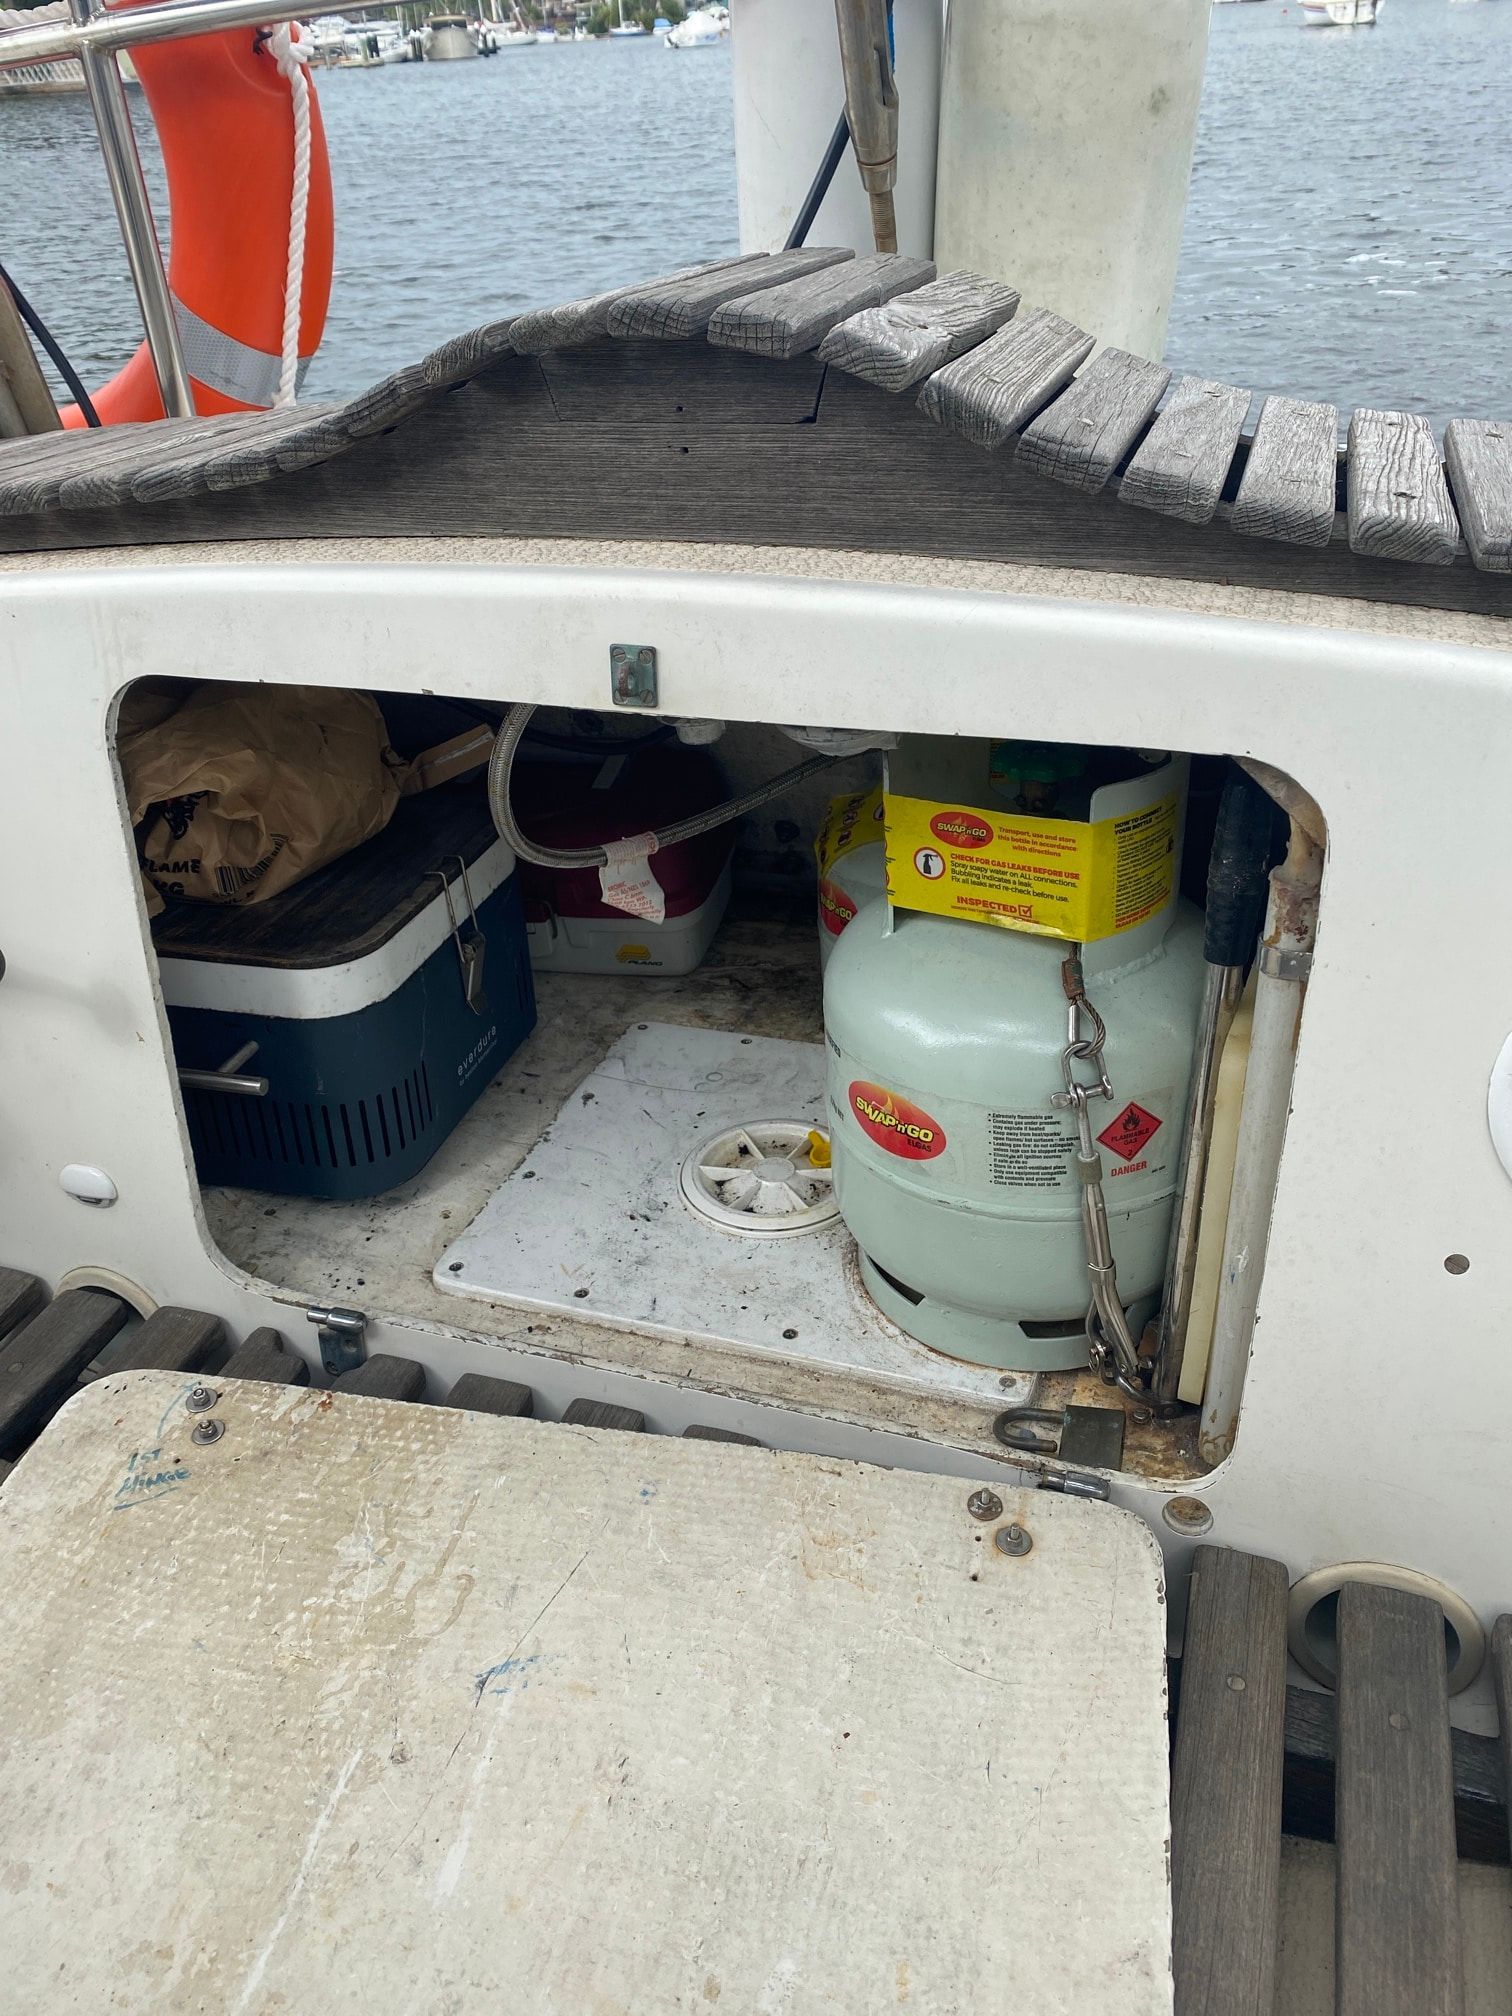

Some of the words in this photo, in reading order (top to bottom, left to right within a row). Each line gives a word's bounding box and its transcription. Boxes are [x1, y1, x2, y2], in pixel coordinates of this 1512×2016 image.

[1114, 820, 1130, 829] HOW
[1131, 816, 1140, 825] TO
[1115, 826, 1132, 835] YOUR
[1132, 818, 1152, 830] BOTTLE
[1011, 836, 1031, 845] bottle
[1040, 841, 1076, 852] accordance
[1058, 836, 1076, 844] store
[1028, 846, 1062, 858] directions
[951, 852, 976, 863] CHECK
[976, 856, 990, 866] FOR
[992, 860, 1007, 869] GAS
[1008, 862, 1032, 872] LEAKS
[1033, 866, 1063, 878] BEFORE
[1064, 872, 1080, 880] USE
[951, 860, 968, 870] Spray
[970, 864, 988, 874] soapy
[990, 868, 1008, 876] water
[1020, 872, 1032, 881] ALL
[1034, 876, 1078, 888] connections.
[951, 868, 981, 881] Bubbling
[982, 873, 1012, 884] indicates
[1018, 879, 1034, 888] leak.
[951, 876, 961, 884] Fix
[962, 877, 970, 885] all
[970, 878, 988, 888] leaks
[988, 882, 1002, 890] and
[1002, 884, 1032, 896] re-check
[1032, 888, 1054, 900] before
[1056, 894, 1069, 902] use.
[956, 896, 1018, 914] INSPECTED
[457, 1025, 496, 1076] everdure
[1111, 1127, 1150, 1142] FLAMMABLE
[1124, 1138, 1138, 1146] GAS
[908, 1138, 932, 1152] ELGAS
[1110, 1160, 1148, 1177] DANGER
